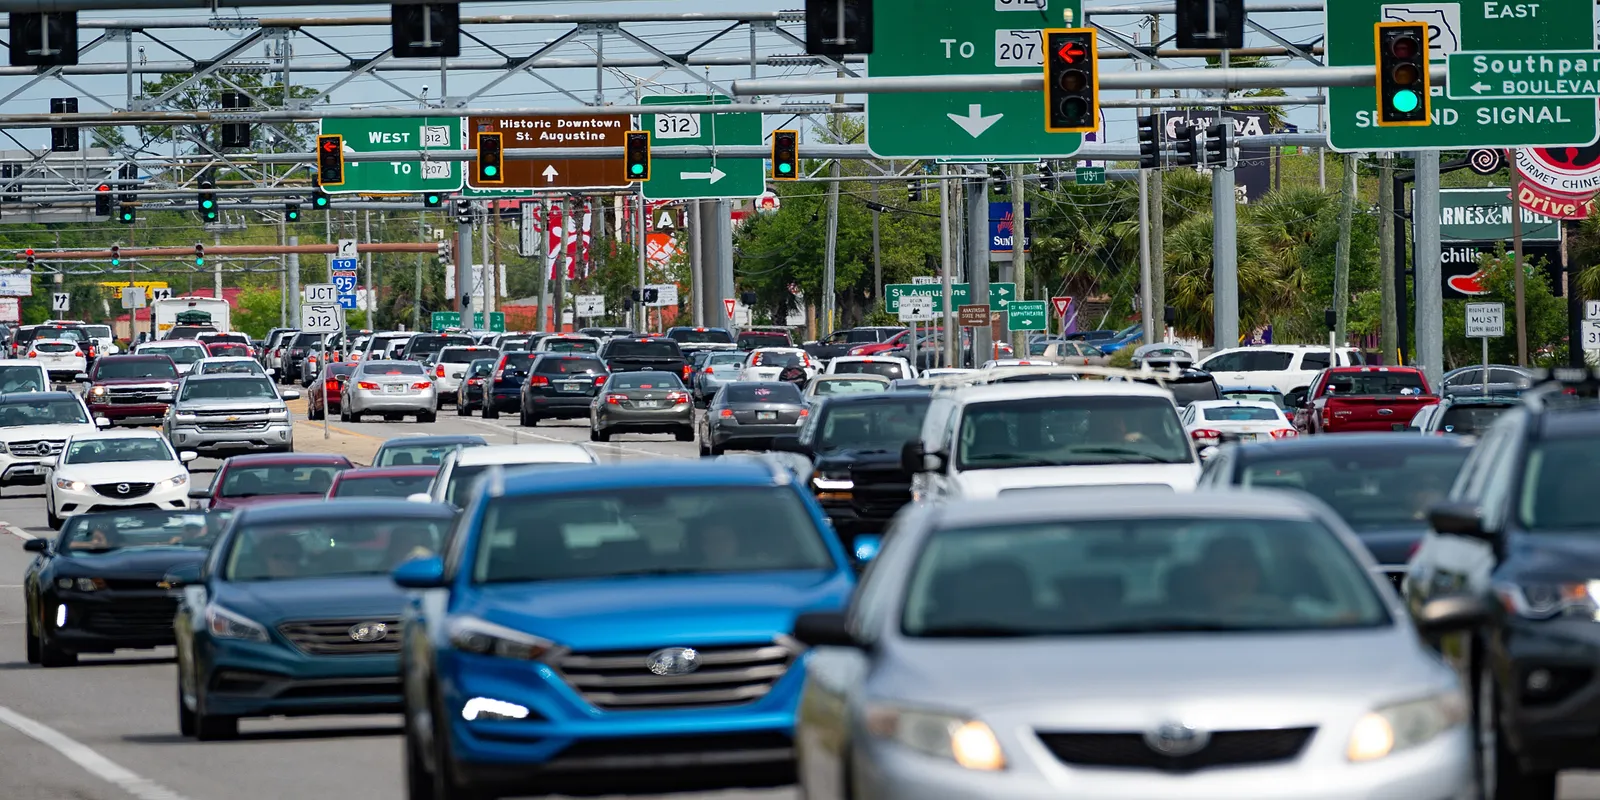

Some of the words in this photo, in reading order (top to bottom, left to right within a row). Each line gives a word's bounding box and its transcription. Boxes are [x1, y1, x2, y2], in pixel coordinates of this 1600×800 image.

[1000, 44, 1036, 60] 207
[1476, 106, 1571, 124] SIGNAL
[500, 119, 551, 128] Historic
[558, 118, 621, 128] Downtown
[659, 118, 690, 132] 312
[426, 134, 441, 142] 312
[516, 132, 533, 141] St.
[540, 131, 606, 142] Augustine
[426, 166, 442, 174] 207
[1516, 151, 1558, 185] OURMET
[1562, 176, 1600, 188] CHINE
[1518, 188, 1576, 216] Drive
[336, 278, 352, 290] 95
[310, 288, 333, 299] JCT
[1591, 304, 1600, 316] J
[308, 316, 330, 326] 312
